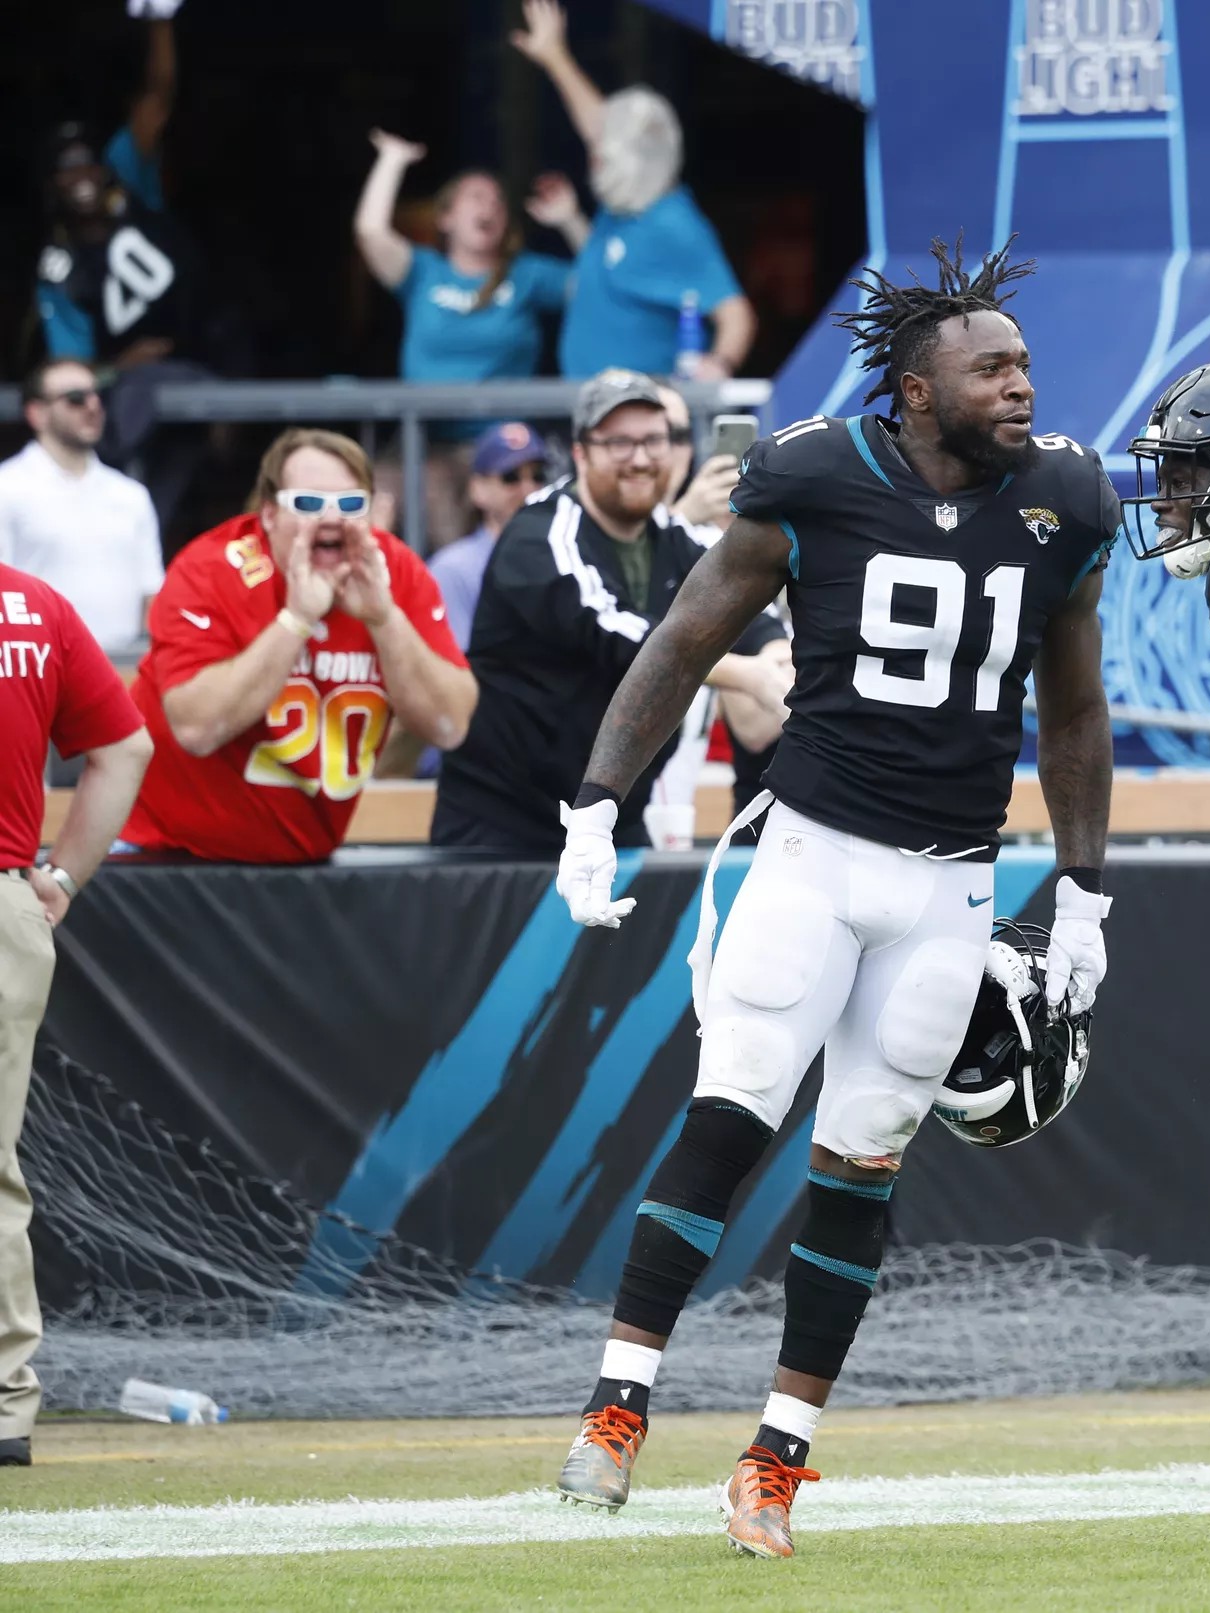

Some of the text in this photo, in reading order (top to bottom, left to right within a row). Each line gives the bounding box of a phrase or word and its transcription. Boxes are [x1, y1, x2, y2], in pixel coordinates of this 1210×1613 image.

[1012, 46, 1173, 115] LIGHT
[104, 227, 175, 336] 20
[0, 641, 51, 679] ITY
[852, 552, 1026, 712] 91
[243, 677, 388, 801] 20
